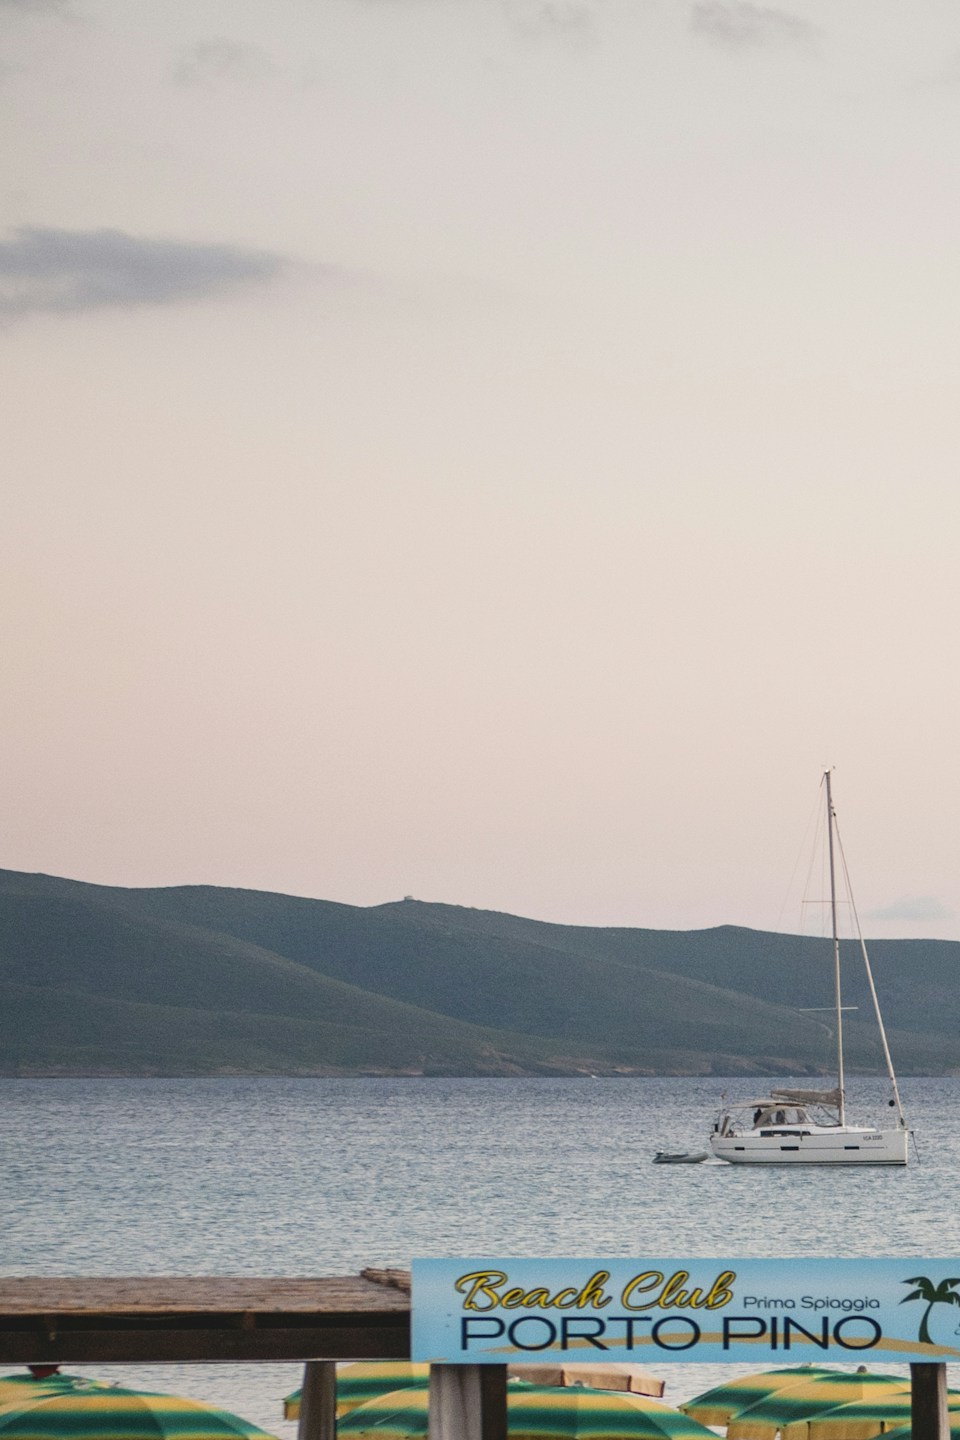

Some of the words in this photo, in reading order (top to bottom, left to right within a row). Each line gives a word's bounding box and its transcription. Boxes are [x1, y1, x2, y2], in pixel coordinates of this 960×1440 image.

[455, 1270, 613, 1312] Beach
[621, 1270, 737, 1311] Club
[743, 1296, 796, 1309] Prima
[801, 1296, 880, 1312] Spiaggia
[461, 1316, 701, 1351] PORTO
[722, 1315, 882, 1351] PINO
